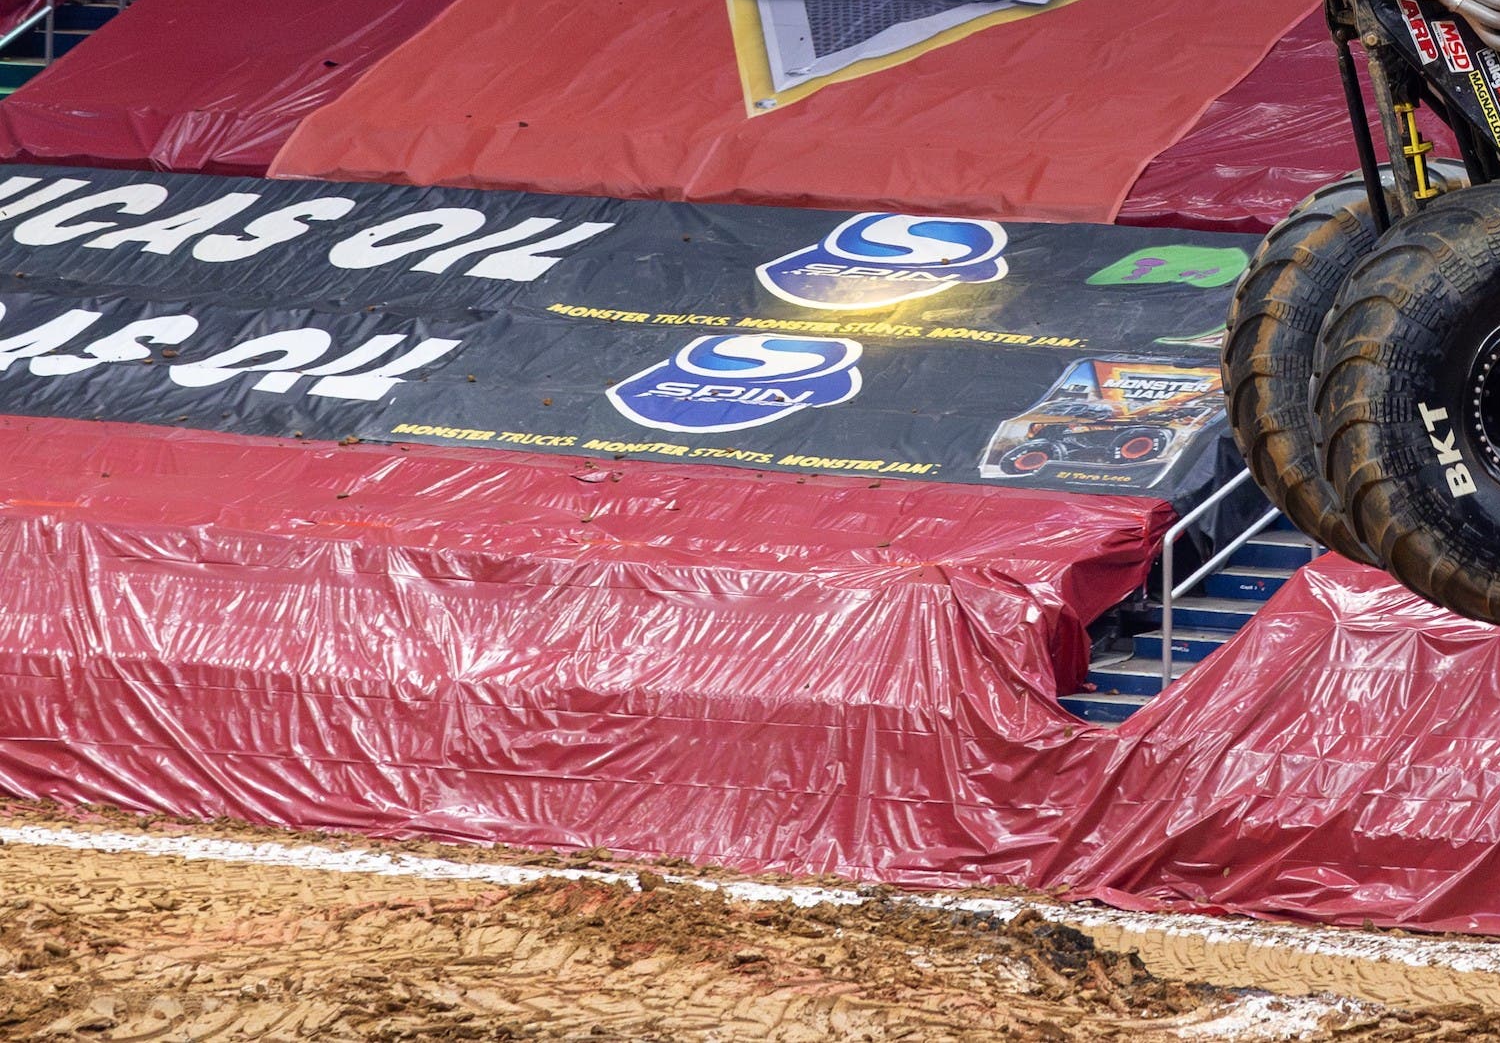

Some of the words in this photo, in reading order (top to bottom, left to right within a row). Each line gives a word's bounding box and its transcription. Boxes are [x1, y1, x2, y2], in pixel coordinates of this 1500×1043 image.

[1440, 21, 1470, 70] MSD
[329, 207, 615, 282] OIL
[803, 262, 960, 283] SPIN
[547, 304, 652, 324] MONSTER
[736, 317, 844, 334] MONSTER
[926, 326, 1034, 345] MONSTER
[169, 328, 462, 401] OIL
[1102, 377, 1214, 394] MONSTER
[655, 381, 814, 405] SPIN
[1123, 389, 1177, 400] JAM
[392, 422, 498, 442] MONSTER
[582, 438, 692, 457] MONSTER
[777, 454, 884, 471] MONSTER
[1418, 401, 1477, 498] BKT
